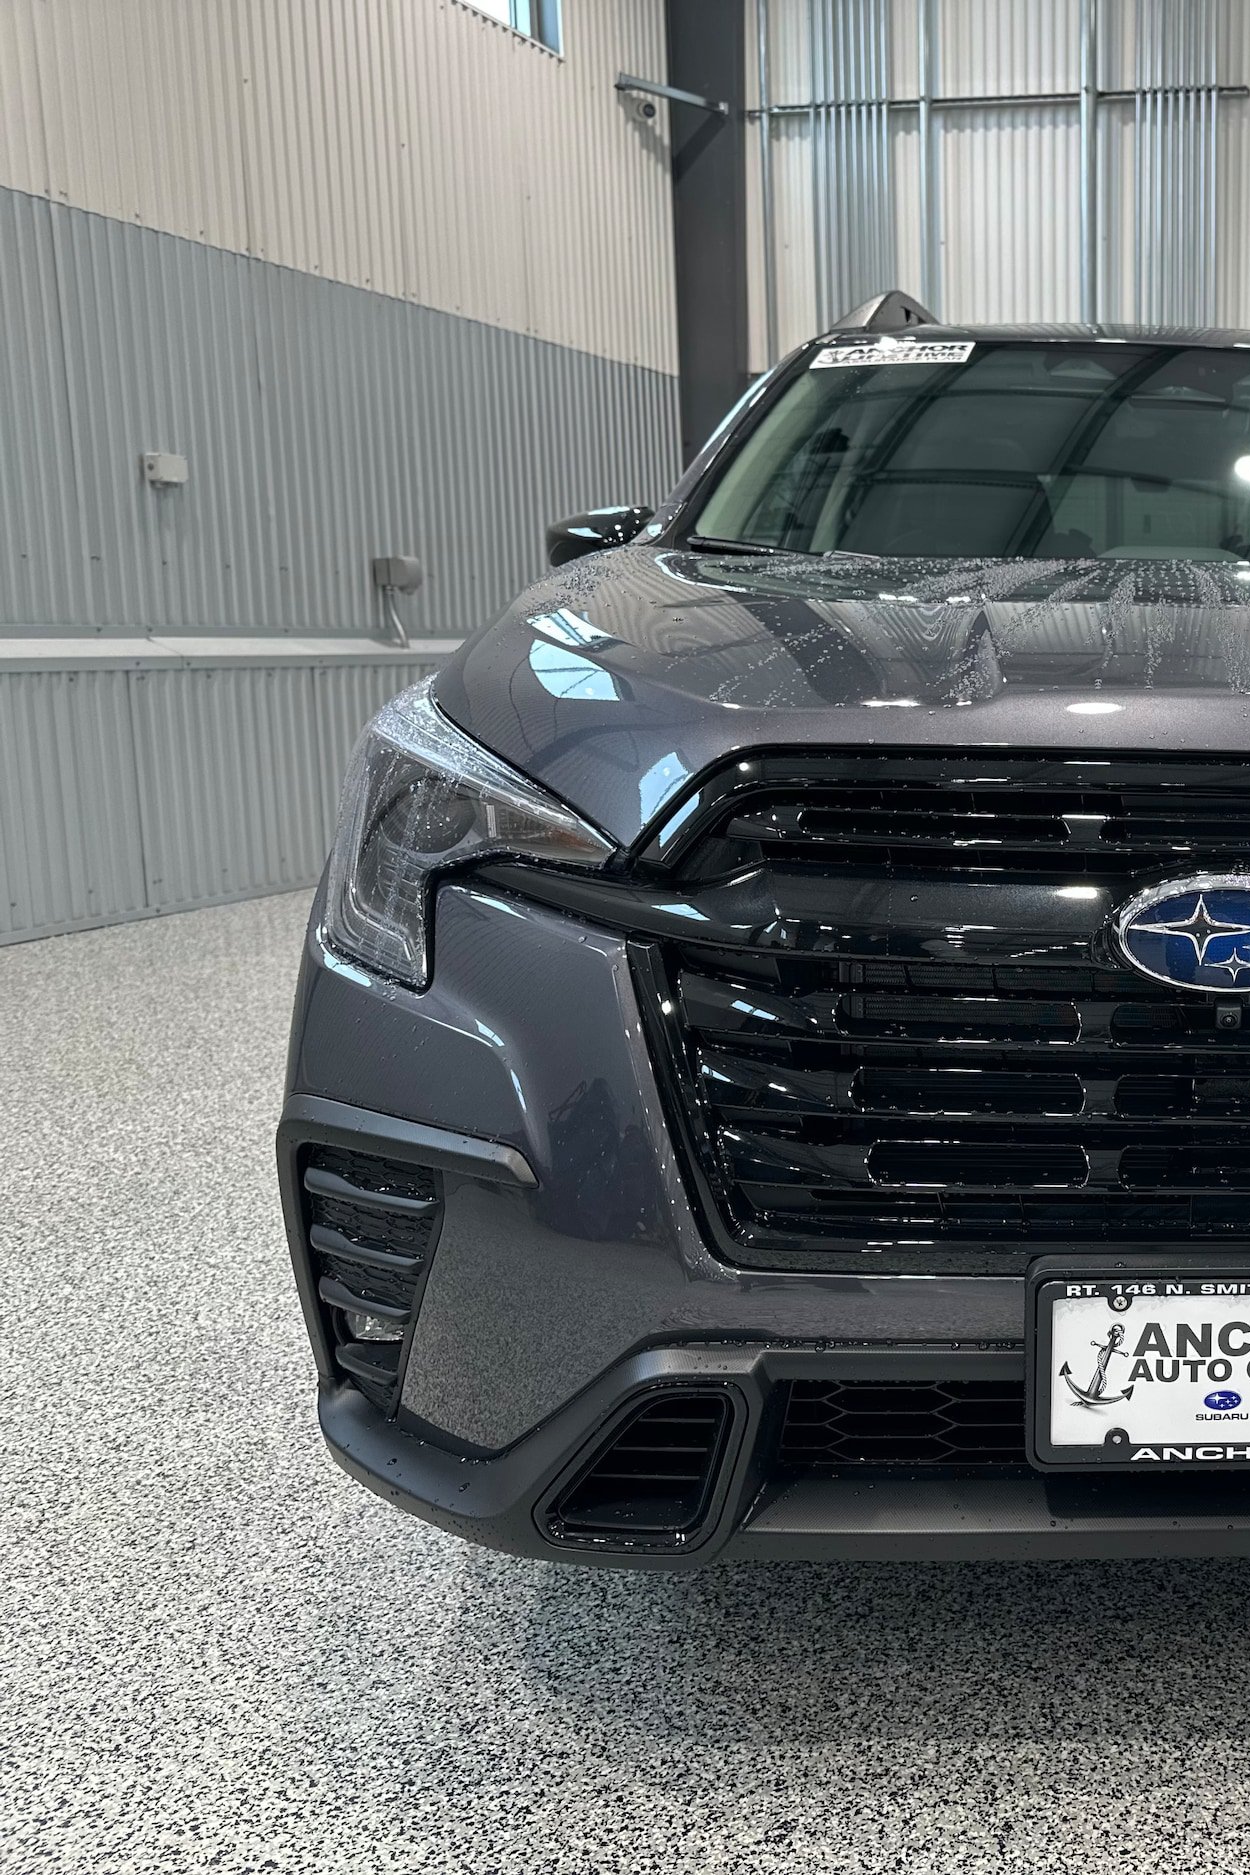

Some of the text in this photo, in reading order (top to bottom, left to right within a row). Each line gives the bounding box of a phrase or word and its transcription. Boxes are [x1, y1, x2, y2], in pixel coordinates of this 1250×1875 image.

[846, 345, 967, 356] ANCHOR
[1066, 1285, 1100, 1296] RT.
[1111, 1284, 1156, 1295] 146
[1166, 1284, 1191, 1294] N.
[1128, 1358, 1233, 1383] AUTO
[1195, 1413, 1250, 1421] SUBARU
